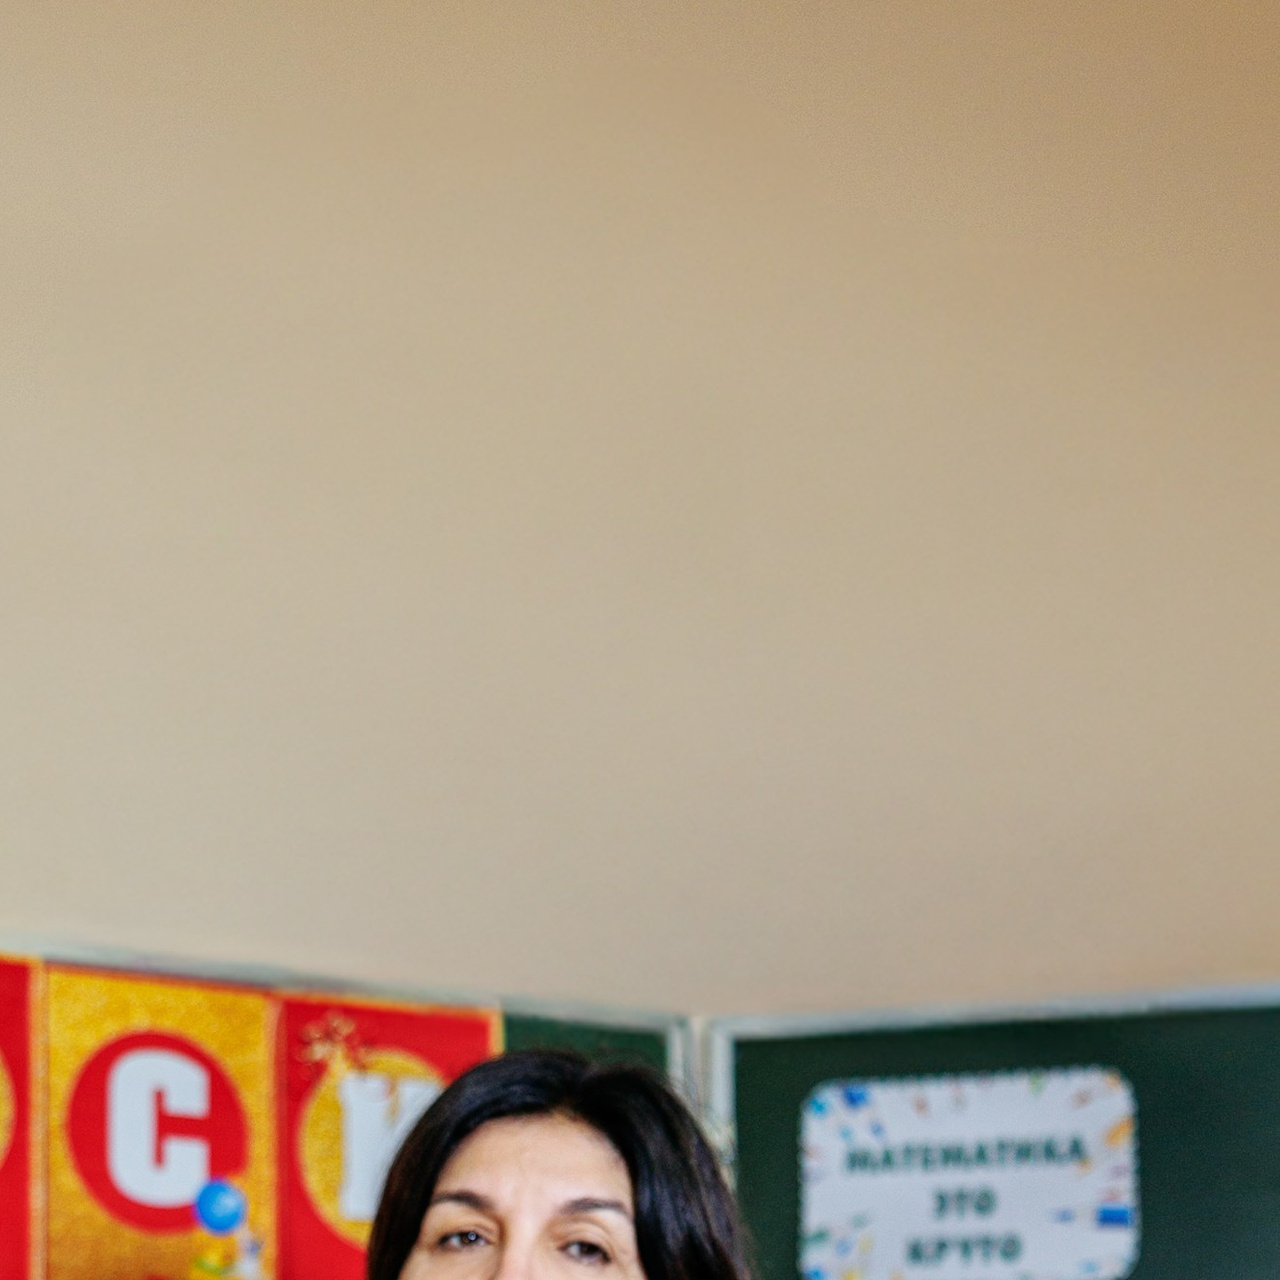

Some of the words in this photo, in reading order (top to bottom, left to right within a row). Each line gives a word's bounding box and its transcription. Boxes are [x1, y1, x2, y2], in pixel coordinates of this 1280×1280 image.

[846, 1136, 1086, 1173] МАТЕМАТИКА
[933, 1186, 996, 1218] ЭТО
[907, 1233, 1022, 1266] КРУТО
